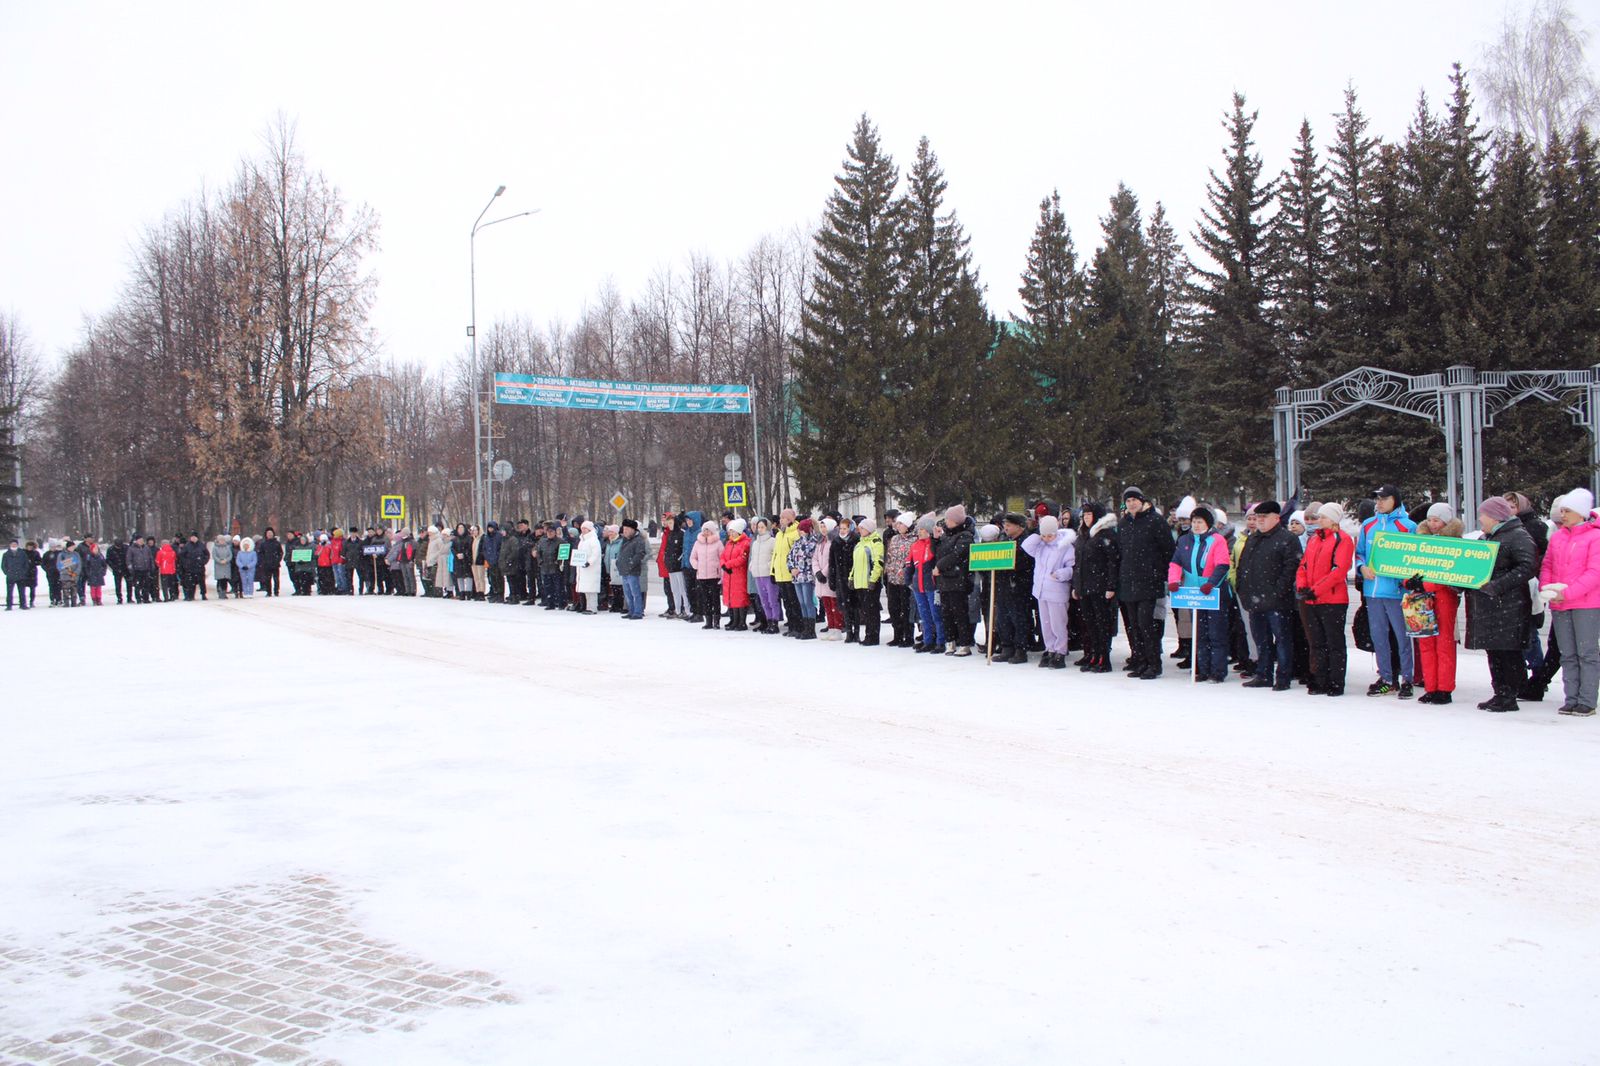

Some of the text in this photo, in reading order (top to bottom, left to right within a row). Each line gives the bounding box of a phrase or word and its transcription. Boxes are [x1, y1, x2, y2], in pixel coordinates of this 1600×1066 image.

[1419, 542, 1462, 558] балалар
[1402, 554, 1455, 569] гуманитар
[1379, 564, 1475, 584] гимназия-интернат
